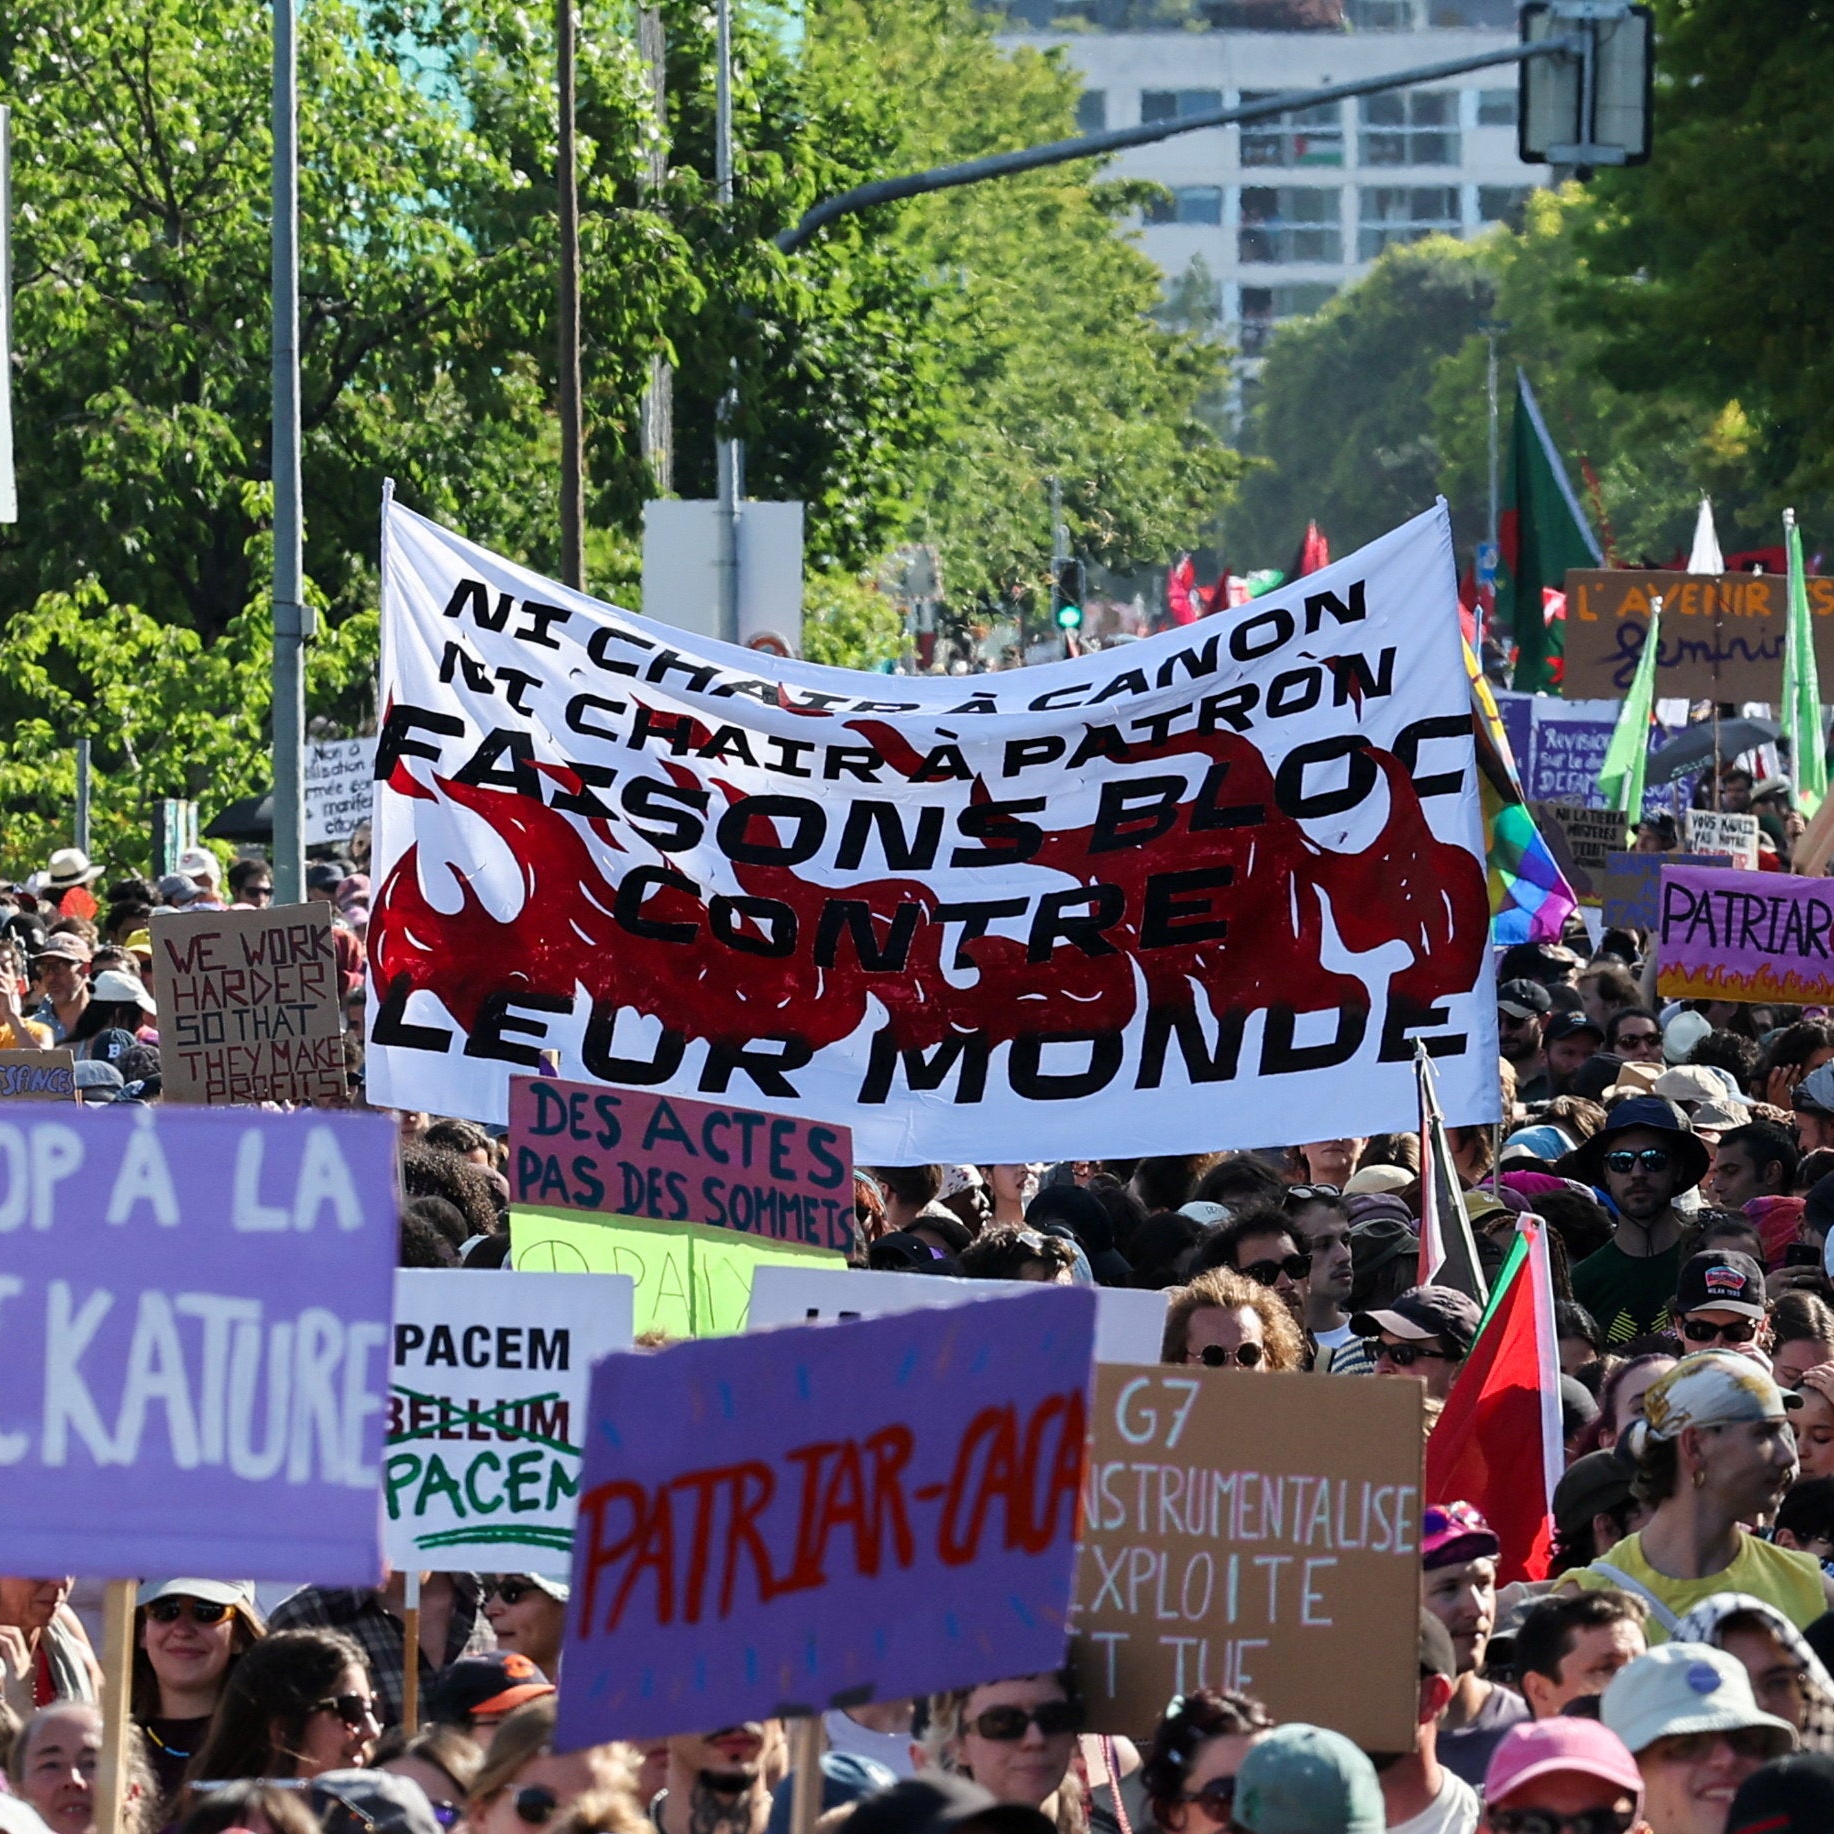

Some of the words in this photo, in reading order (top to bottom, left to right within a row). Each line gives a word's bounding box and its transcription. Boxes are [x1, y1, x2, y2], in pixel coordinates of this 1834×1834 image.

[1578, 582, 1772, 621] L'AVENIR
[445, 577, 570, 648] NI
[586, 626, 902, 715] CHAIR
[1029, 580, 1367, 711] CANON
[440, 643, 544, 719] NI
[569, 697, 881, 783] CHAIR
[902, 729, 973, 783] À
[1005, 646, 1394, 776] PATRON
[376, 702, 1049, 872] FAISONS
[1088, 714, 1474, 851] BLOC
[1692, 813, 1716, 829] VOUS
[164, 932, 227, 974] WE
[240, 923, 335, 967] WORK
[612, 864, 1232, 973] CONTRE
[173, 962, 328, 1012] HARDER
[175, 1010, 225, 1047] SO
[232, 1003, 318, 1042] THAT
[177, 1041, 263, 1082] THEY
[270, 1035, 347, 1077] MAKE
[372, 988, 815, 1098] LEUR
[858, 1000, 1468, 1103] MONDE
[205, 1068, 343, 1105] PROFITS
[106, 1105, 181, 1227] À
[232, 1127, 365, 1232] LA
[529, 1082, 623, 1150] DES
[642, 1096, 845, 1190] ACTES
[519, 1145, 606, 1208] PAS
[617, 1161, 688, 1222] DES
[702, 1176, 856, 1254] SOMMETS
[395, 1324, 570, 1371] PACEM
[385, 1399, 570, 1444] BELLUM
[1115, 1376, 1200, 1449] G7
[1084, 1461, 1418, 1556] NSTRUMENTALISE
